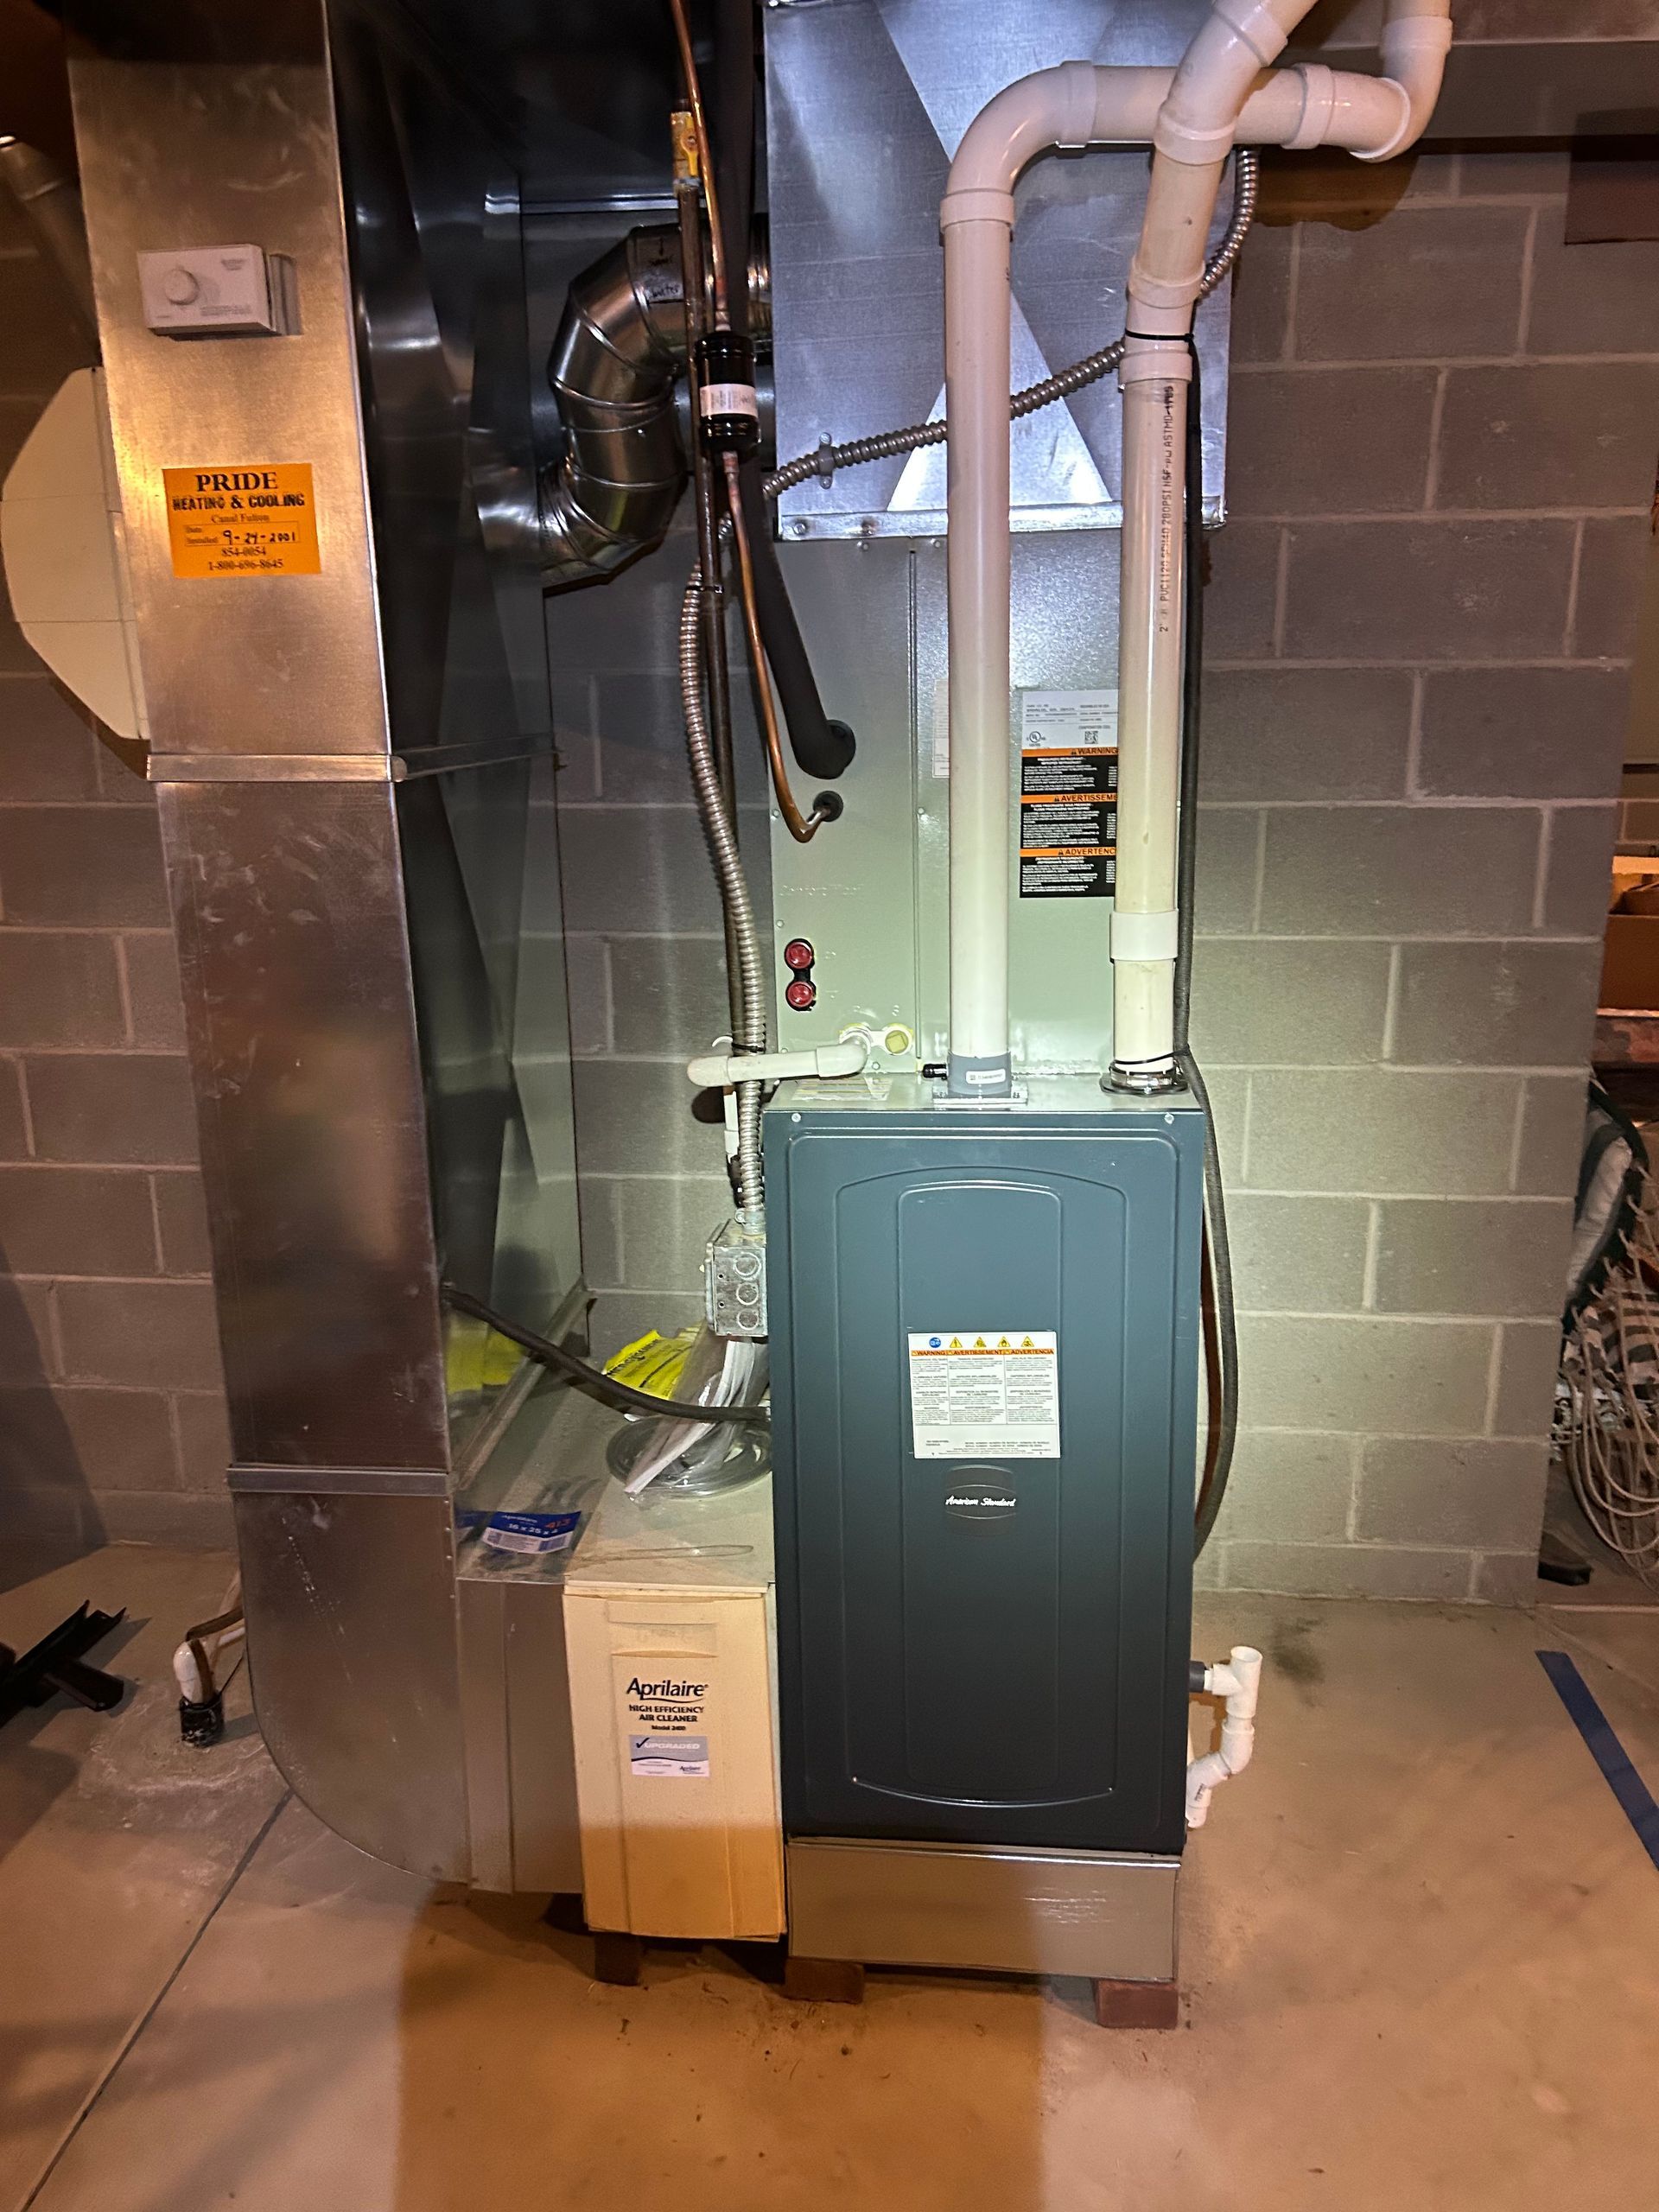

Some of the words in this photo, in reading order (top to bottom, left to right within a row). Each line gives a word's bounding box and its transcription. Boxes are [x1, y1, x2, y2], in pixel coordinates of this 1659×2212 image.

[196, 472, 277, 492] PRIDE
[173, 493, 225, 511] HEATING
[231, 494, 244, 510] &
[248, 493, 305, 508] COOLING
[1078, 747, 1118, 755] WARNING
[945, 1495, 979, 1505] American
[980, 1497, 1017, 1507] Standard
[626, 1677, 704, 1700] Aprilaire
[629, 1704, 652, 1713] HIGH
